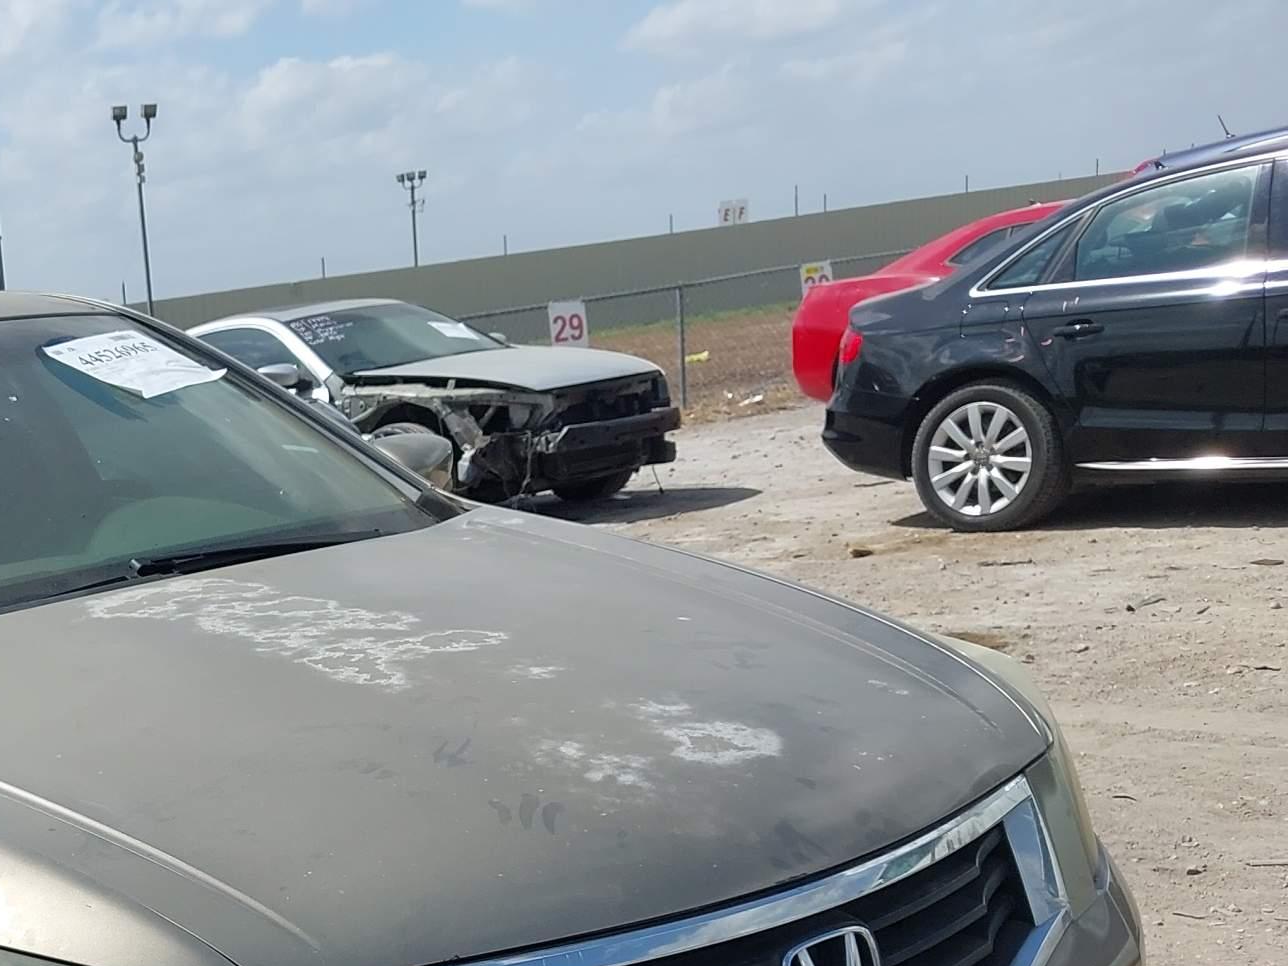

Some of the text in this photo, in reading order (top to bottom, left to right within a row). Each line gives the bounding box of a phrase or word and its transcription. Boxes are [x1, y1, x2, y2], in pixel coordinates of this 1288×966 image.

[723, 206, 745, 222] E F
[553, 313, 584, 343] 29
[78, 342, 157, 367] 44526965
